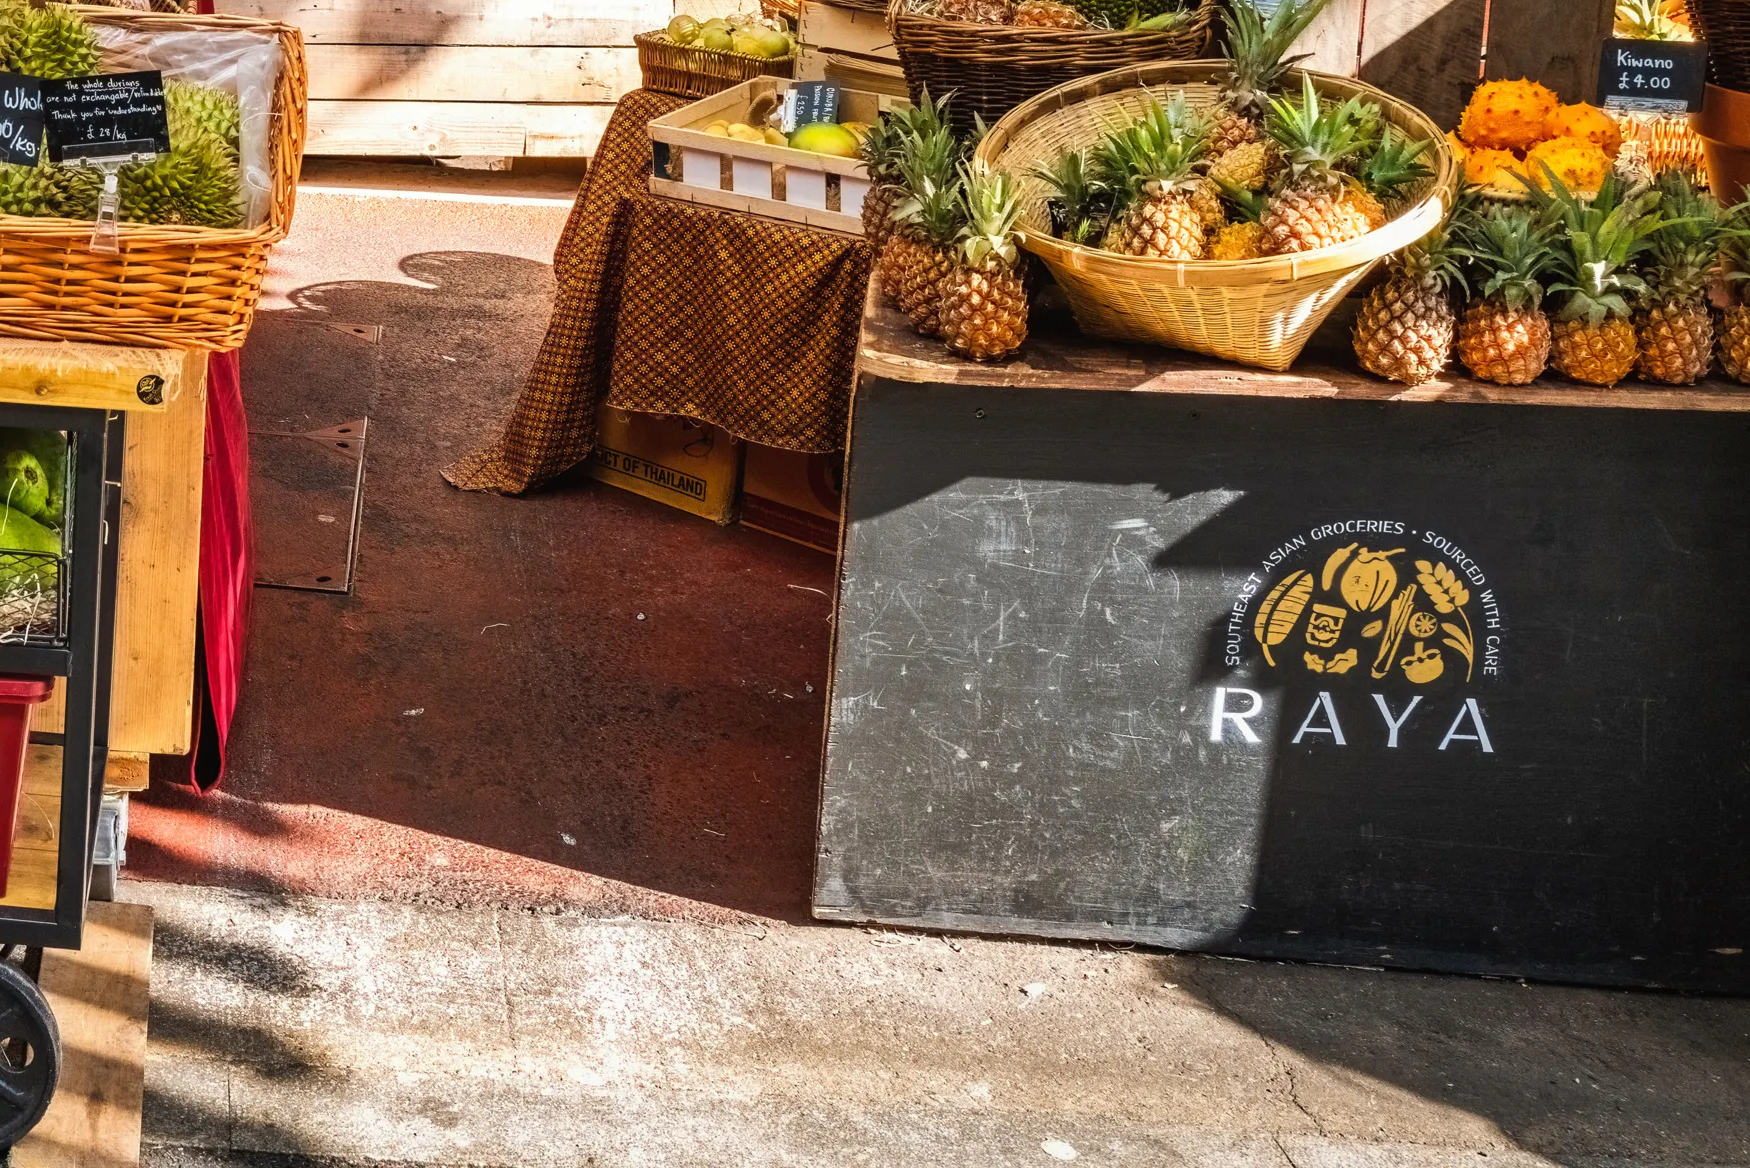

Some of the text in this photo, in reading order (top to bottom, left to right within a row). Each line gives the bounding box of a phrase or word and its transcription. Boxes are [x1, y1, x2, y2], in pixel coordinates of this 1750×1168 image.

[1617, 49, 1674, 69] Kiwano
[83, 79, 140, 90] whole durians
[1618, 72, 1671, 89] £4.00
[4, 87, 43, 111] Whol
[63, 94, 77, 102] not
[813, 85, 823, 106] PASSION
[51, 110, 78, 121] Thank
[81, 111, 94, 119] you
[94, 108, 105, 119] for
[623, 457, 639, 471] OF
[642, 463, 704, 497] THAILAND
[1225, 519, 1500, 676] SOUTHEAST ASIAN GROCERIES SOURCED WITH CARE
[1209, 686, 1494, 753] RAYA
